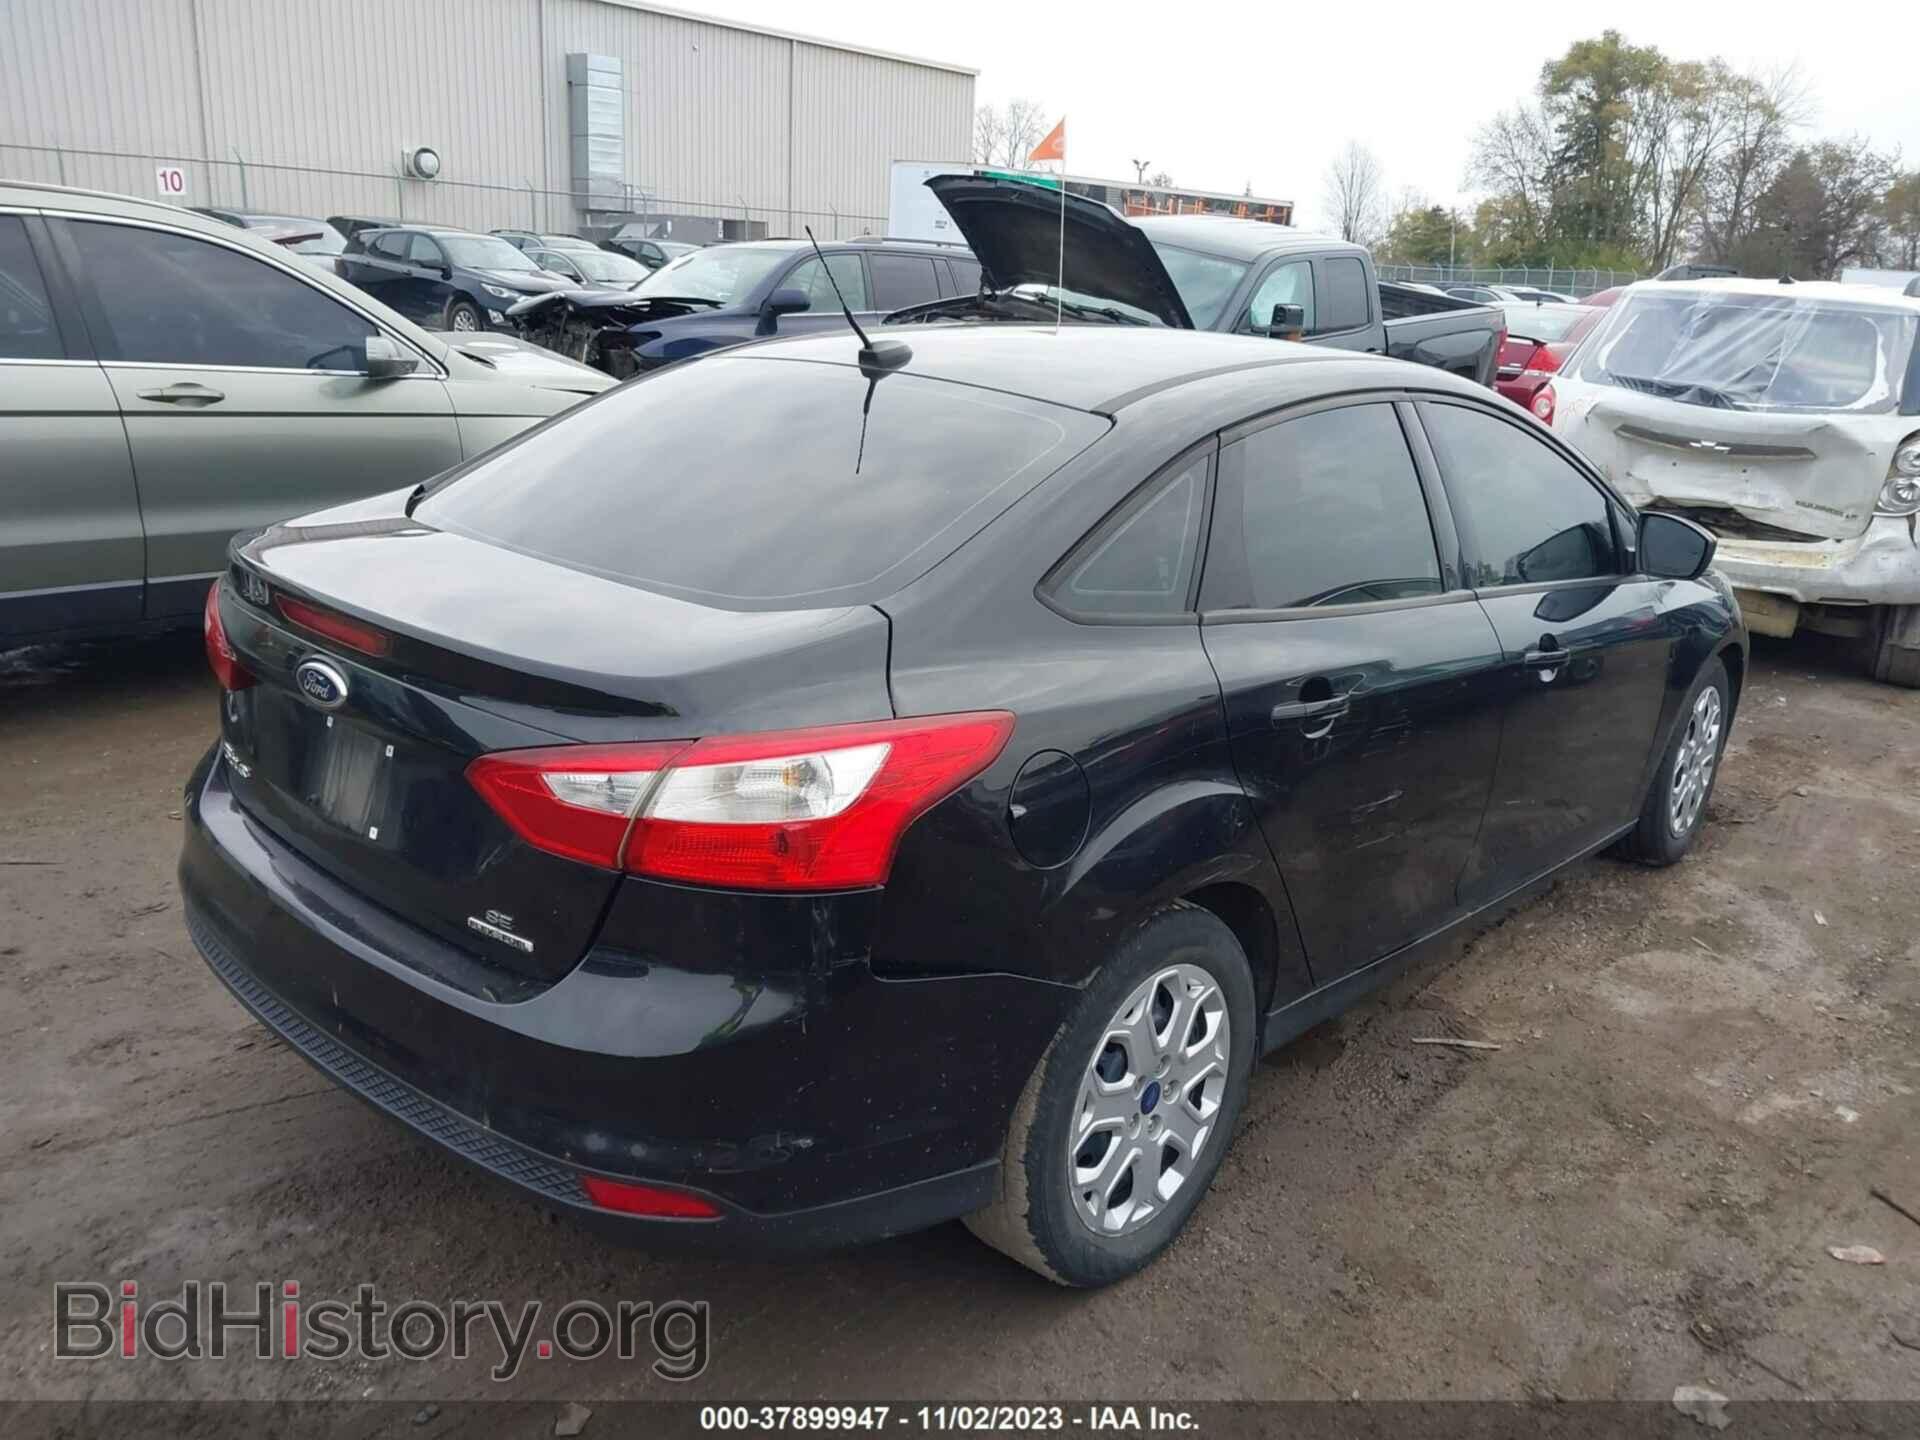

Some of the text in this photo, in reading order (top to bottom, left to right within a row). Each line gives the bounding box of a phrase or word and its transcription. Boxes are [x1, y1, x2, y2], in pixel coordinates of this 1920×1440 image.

[159, 170, 183, 192] 10
[303, 670, 330, 699] Ford
[485, 909, 512, 930] SE
